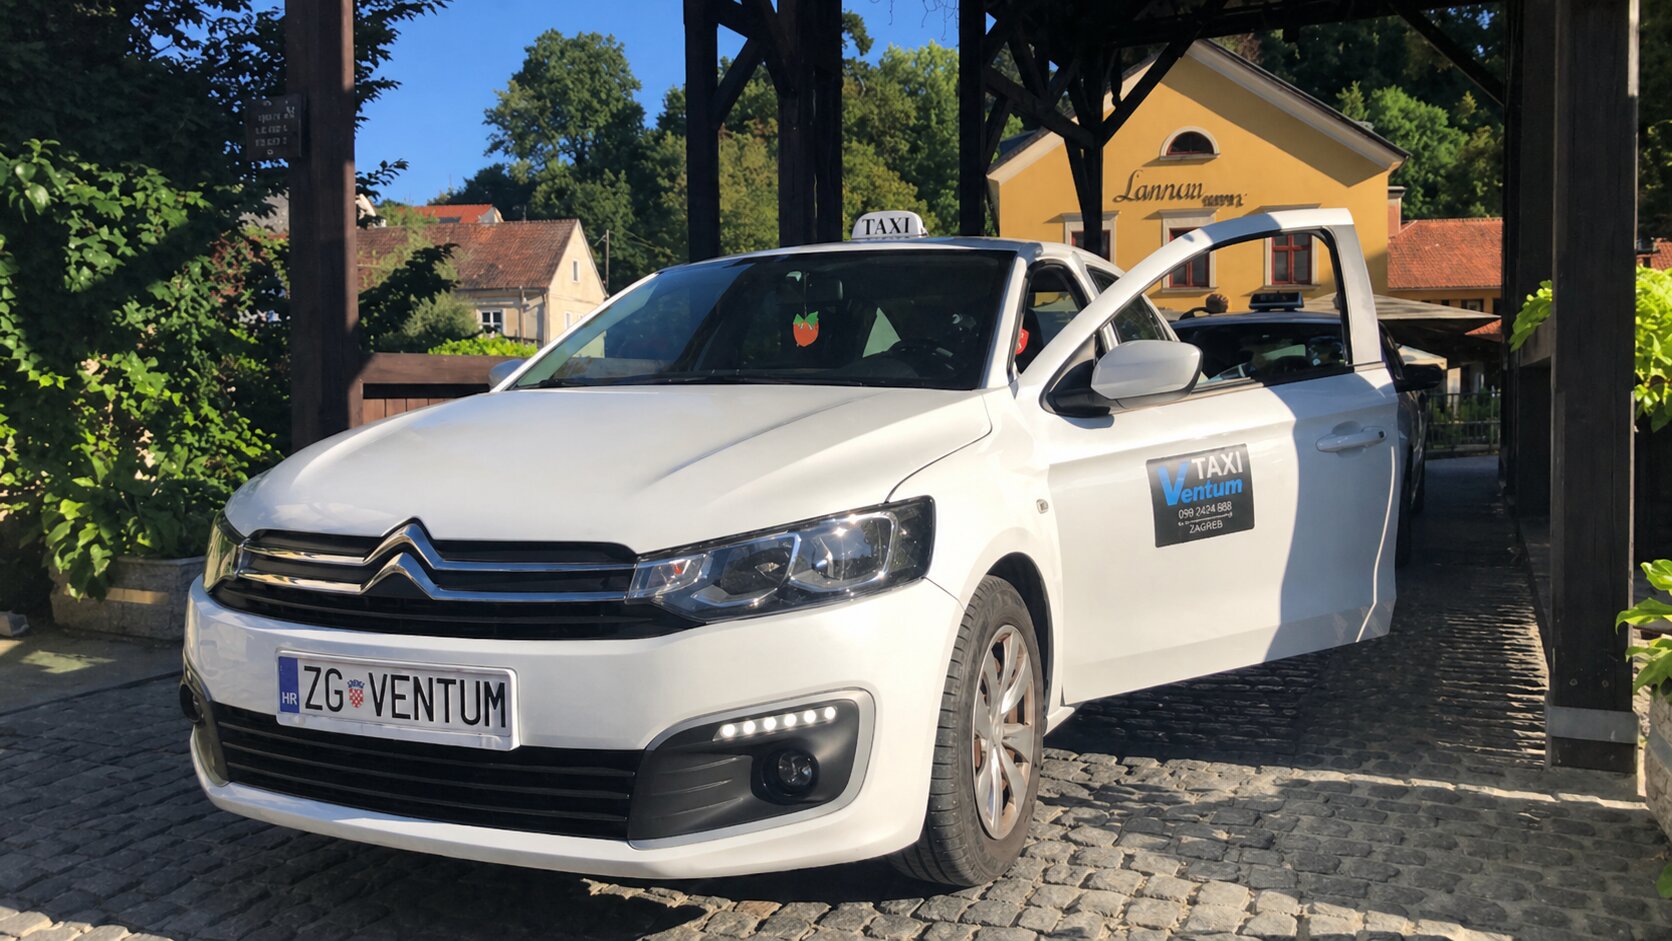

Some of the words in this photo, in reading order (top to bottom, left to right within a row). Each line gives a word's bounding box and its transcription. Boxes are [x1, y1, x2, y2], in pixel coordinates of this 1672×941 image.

[862, 217, 909, 235] TAXI
[1191, 451, 1243, 480] TAXI
[1157, 459, 1243, 506] Ventum
[1189, 520, 1223, 533] ZAGREB
[281, 691, 297, 706] HR
[304, 665, 344, 713] ZG
[368, 672, 507, 728] VENTUM
